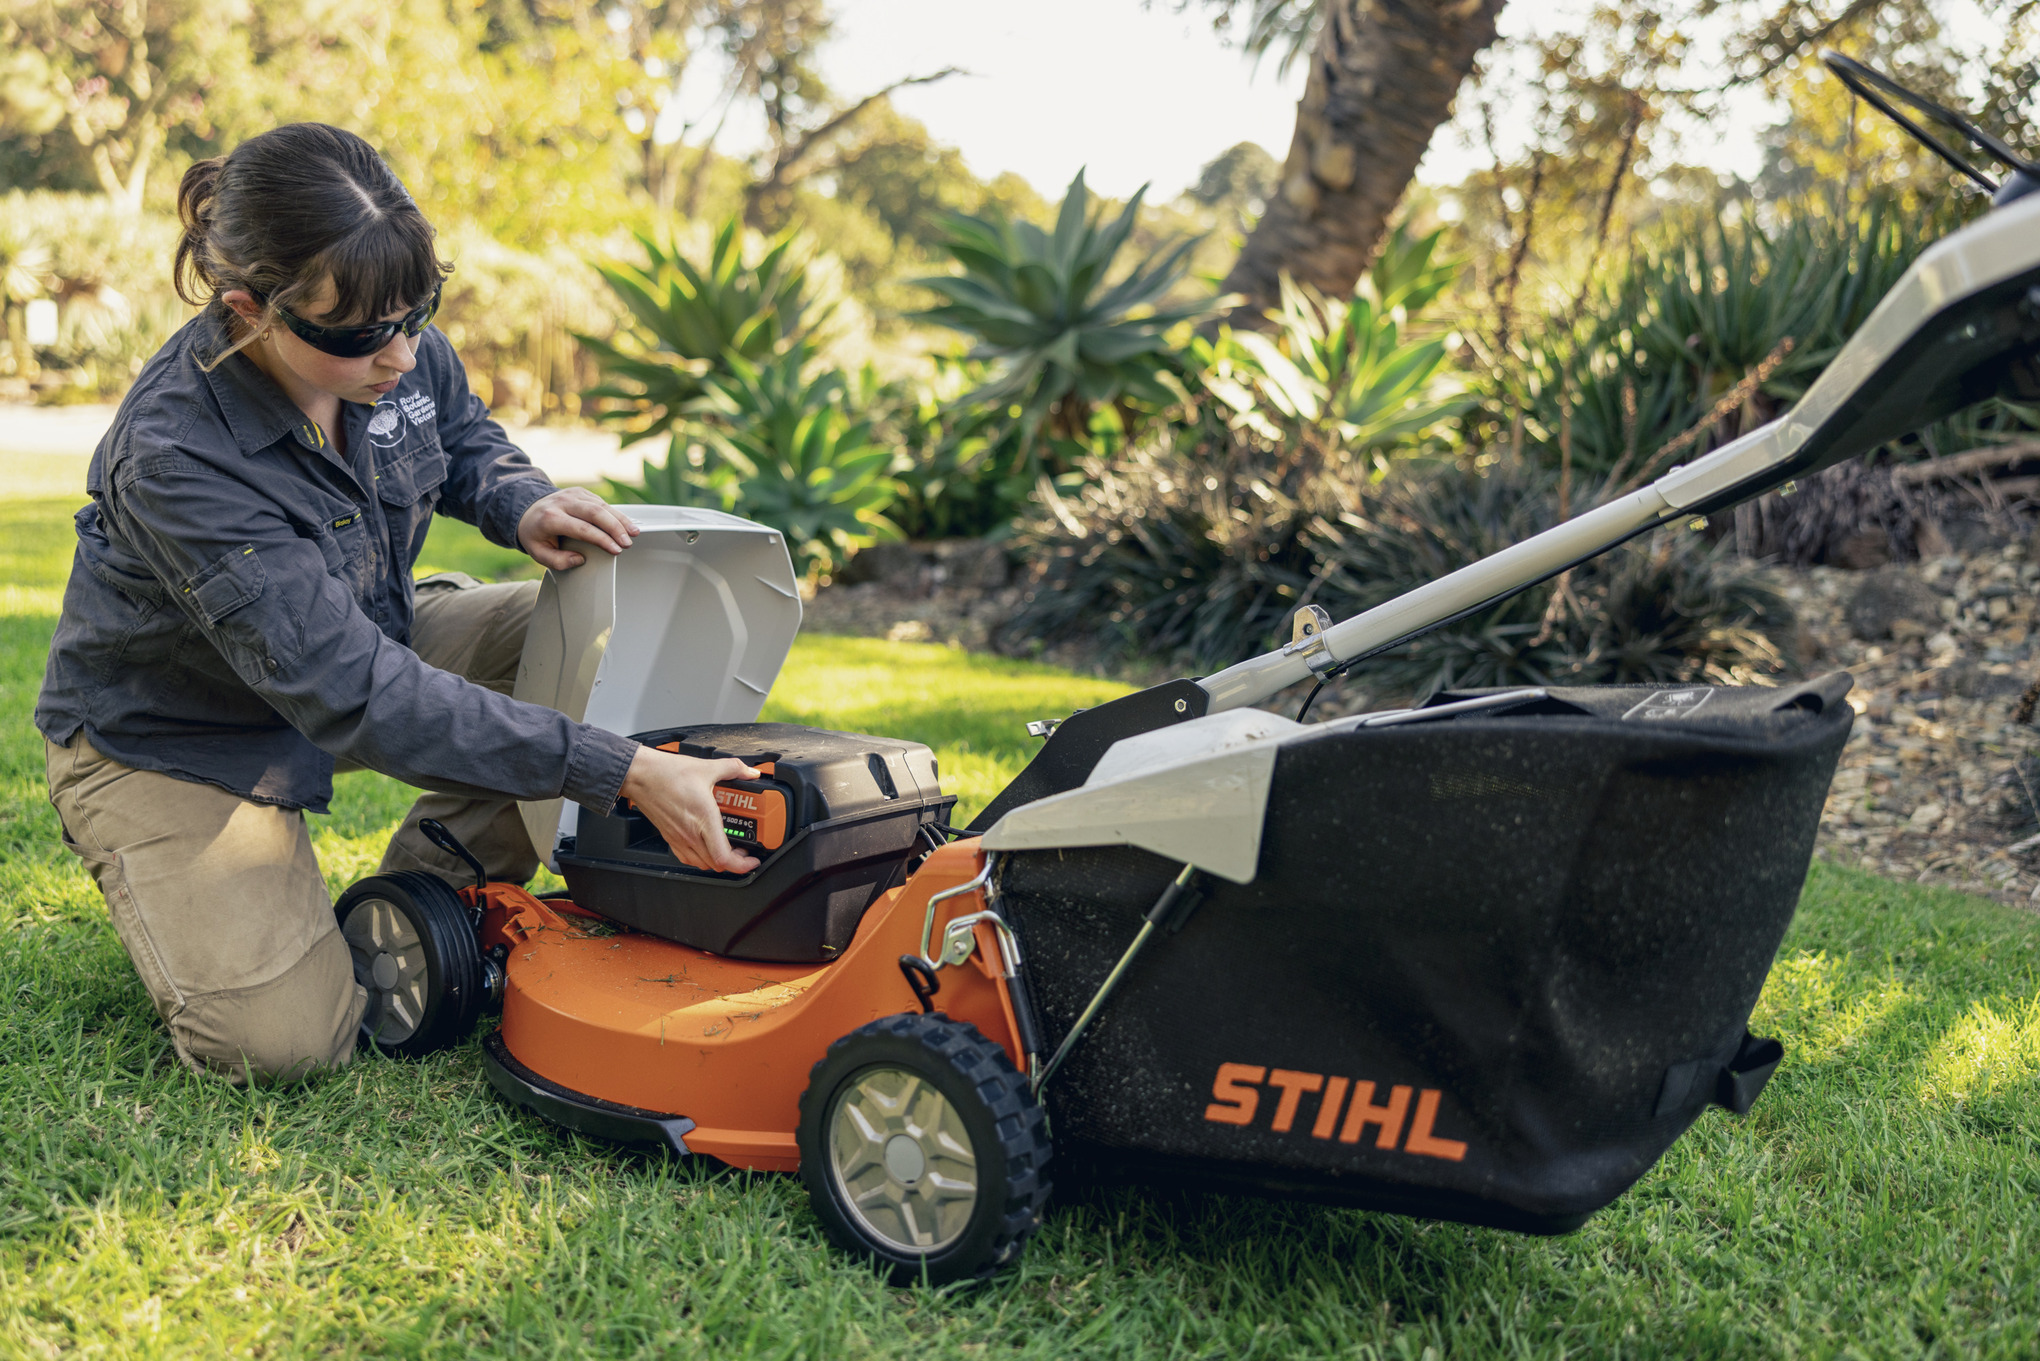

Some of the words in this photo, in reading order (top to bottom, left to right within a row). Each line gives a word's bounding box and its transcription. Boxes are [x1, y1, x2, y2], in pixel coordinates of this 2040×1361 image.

[399, 390, 421, 406] Royal
[403, 396, 431, 413] Botanic
[716, 790, 757, 811] STIHL
[1204, 1062, 1468, 1162] STIHL
